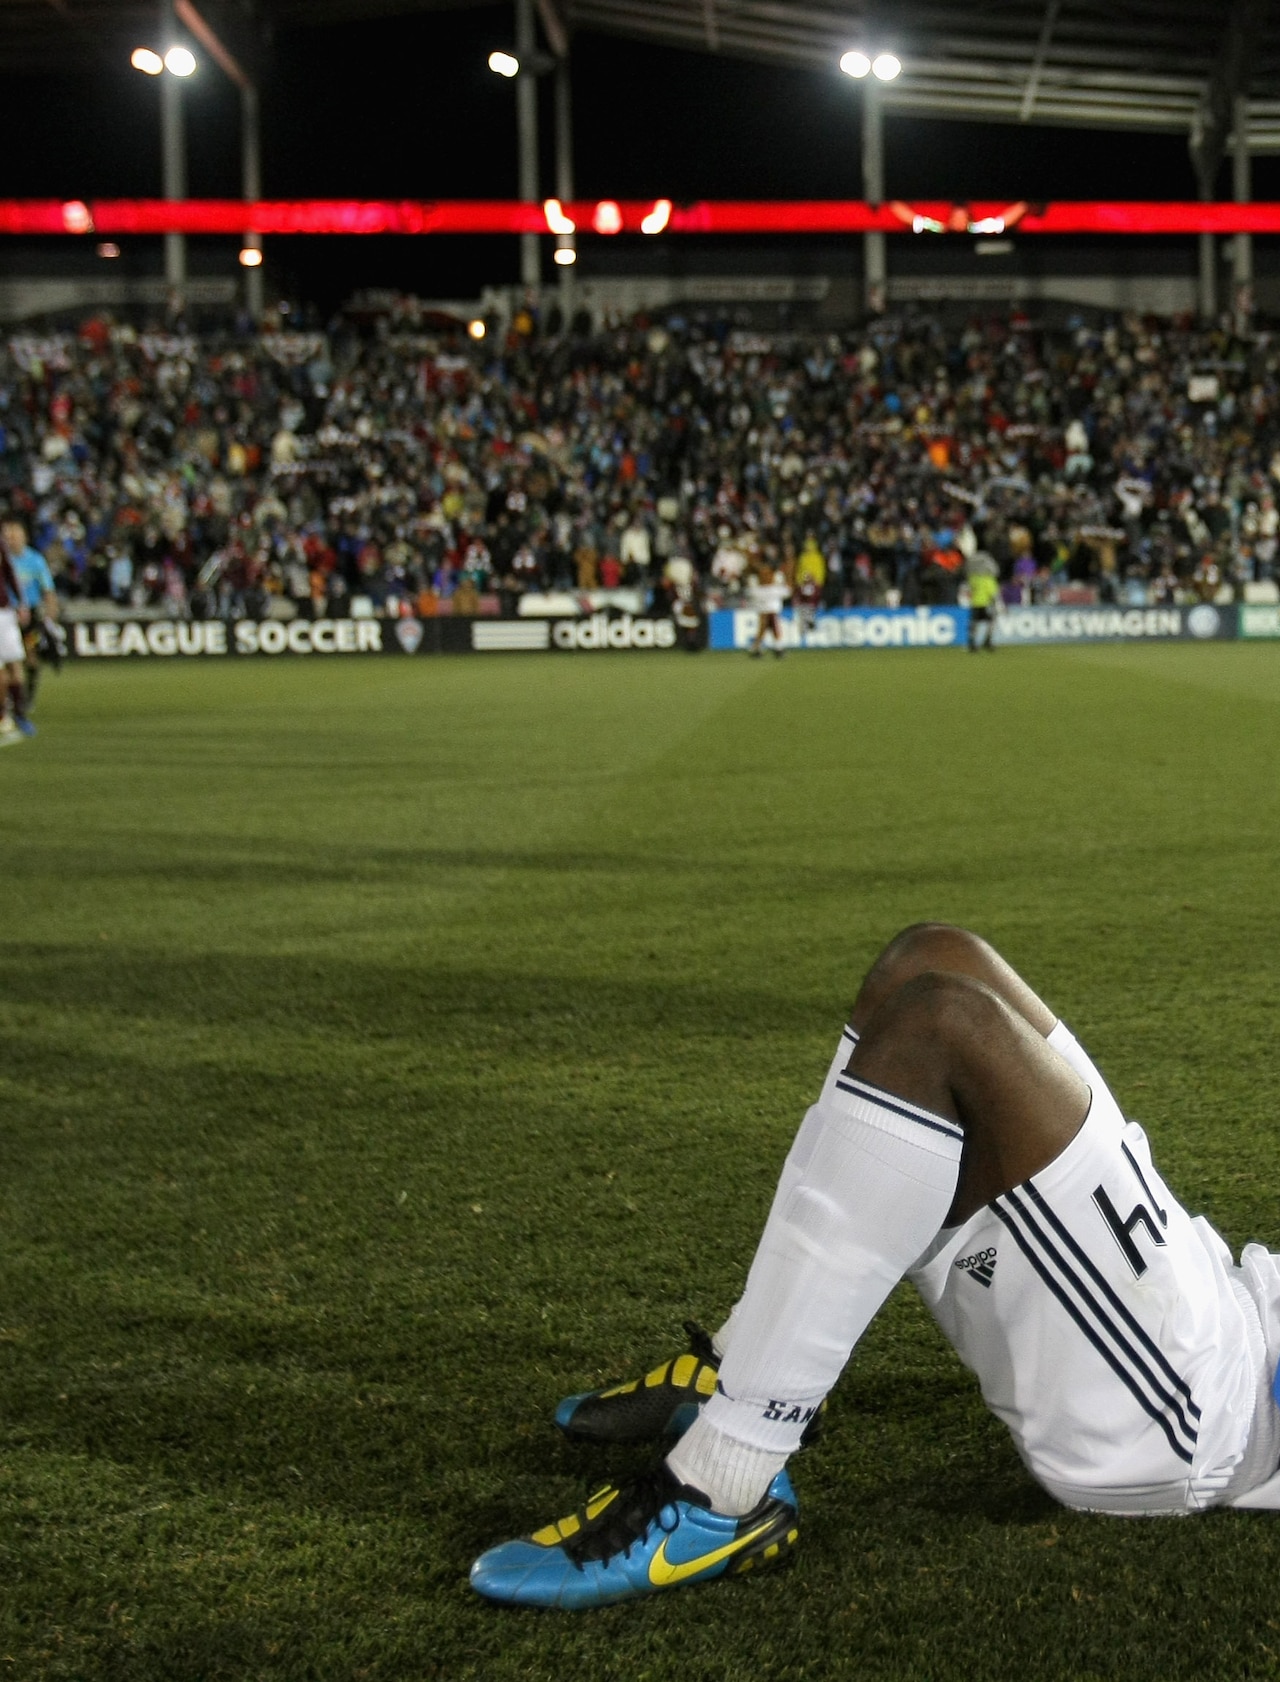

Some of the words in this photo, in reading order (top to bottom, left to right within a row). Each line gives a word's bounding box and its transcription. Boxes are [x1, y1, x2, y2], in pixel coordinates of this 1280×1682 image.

[75, 620, 227, 656] LEAGUE
[234, 618, 382, 653] SOCCER
[553, 612, 676, 649] adidas
[999, 609, 1182, 637] VOLKSWAGEN
[955, 1247, 997, 1270] adidas
